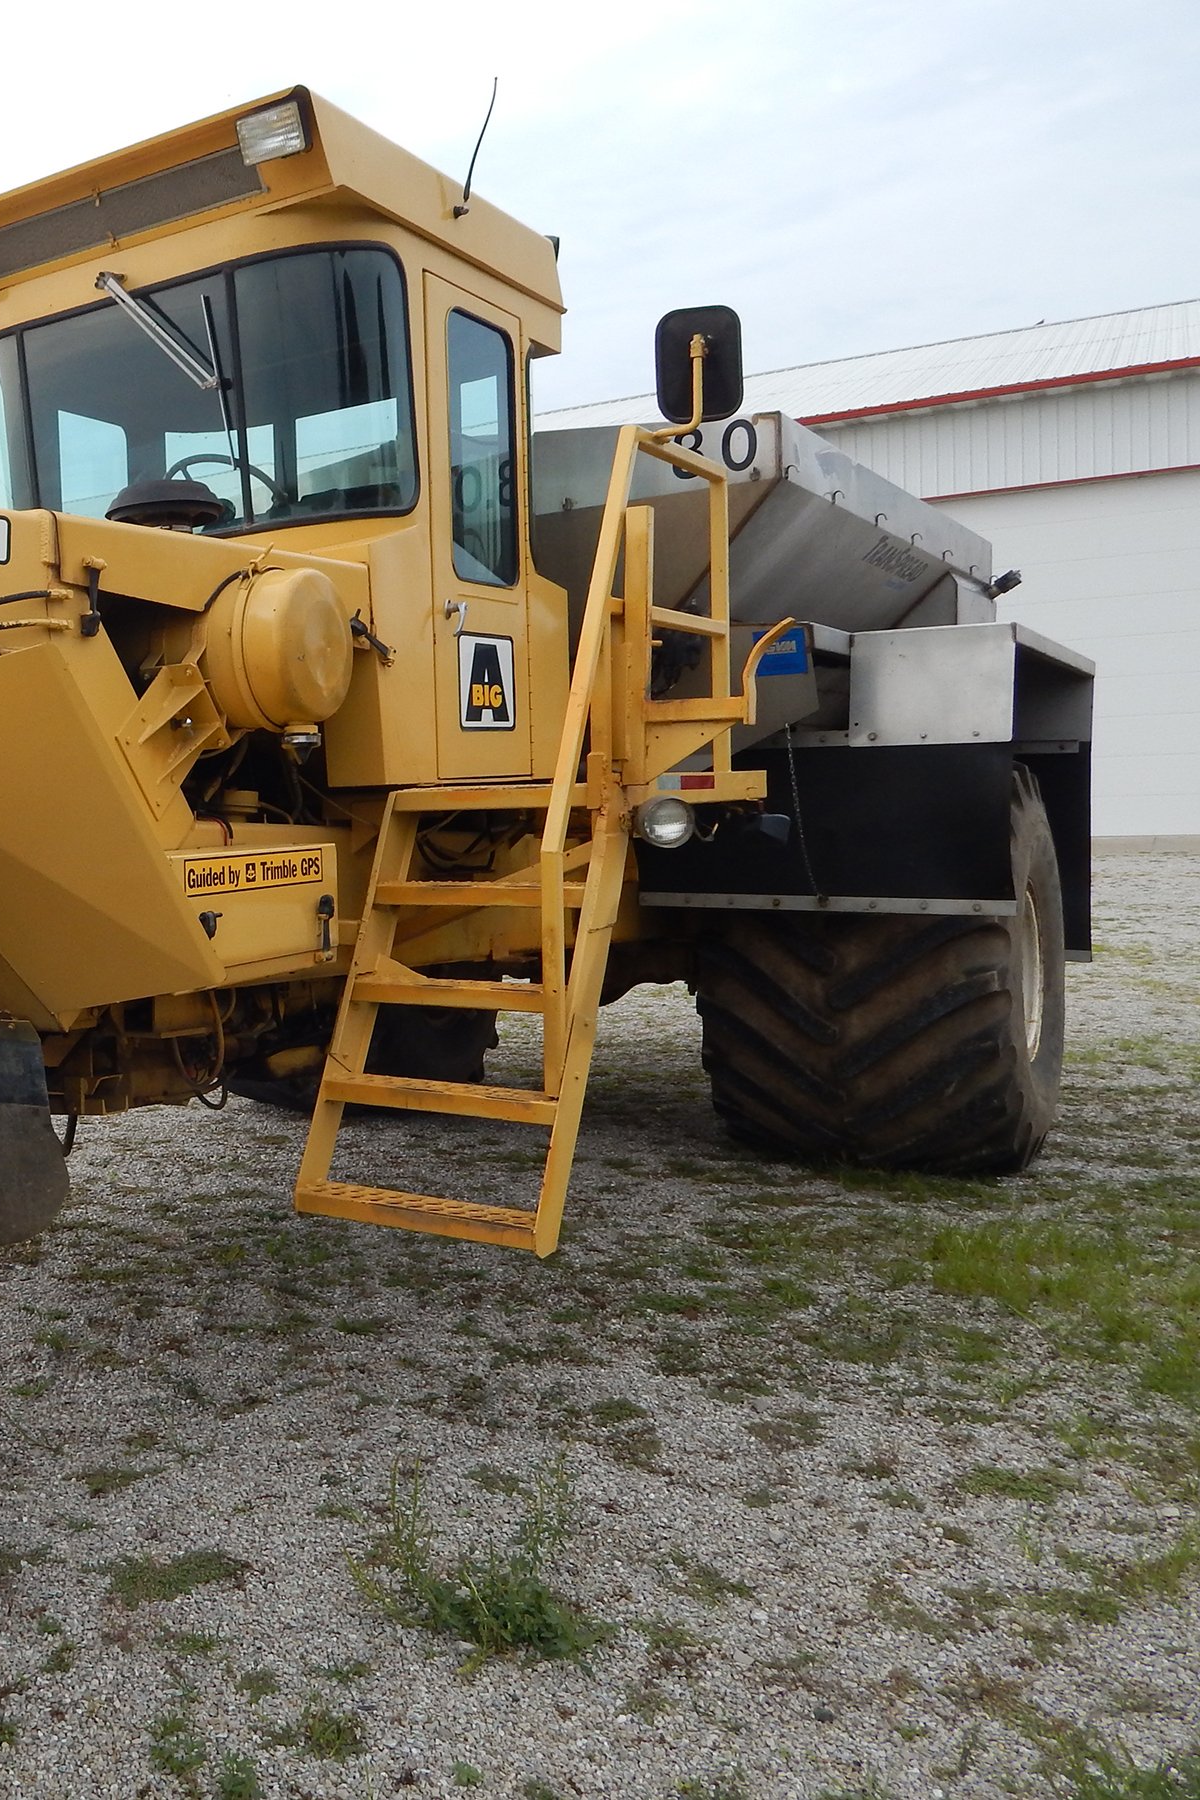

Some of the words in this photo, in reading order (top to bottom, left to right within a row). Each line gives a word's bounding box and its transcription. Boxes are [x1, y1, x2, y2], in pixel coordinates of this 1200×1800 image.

[464, 642, 510, 722] A
[471, 683, 503, 708] BIG
[187, 866, 225, 889] Guided
[228, 865, 241, 888] by
[260, 859, 297, 881] Trimble
[300, 857, 320, 877] GPS
